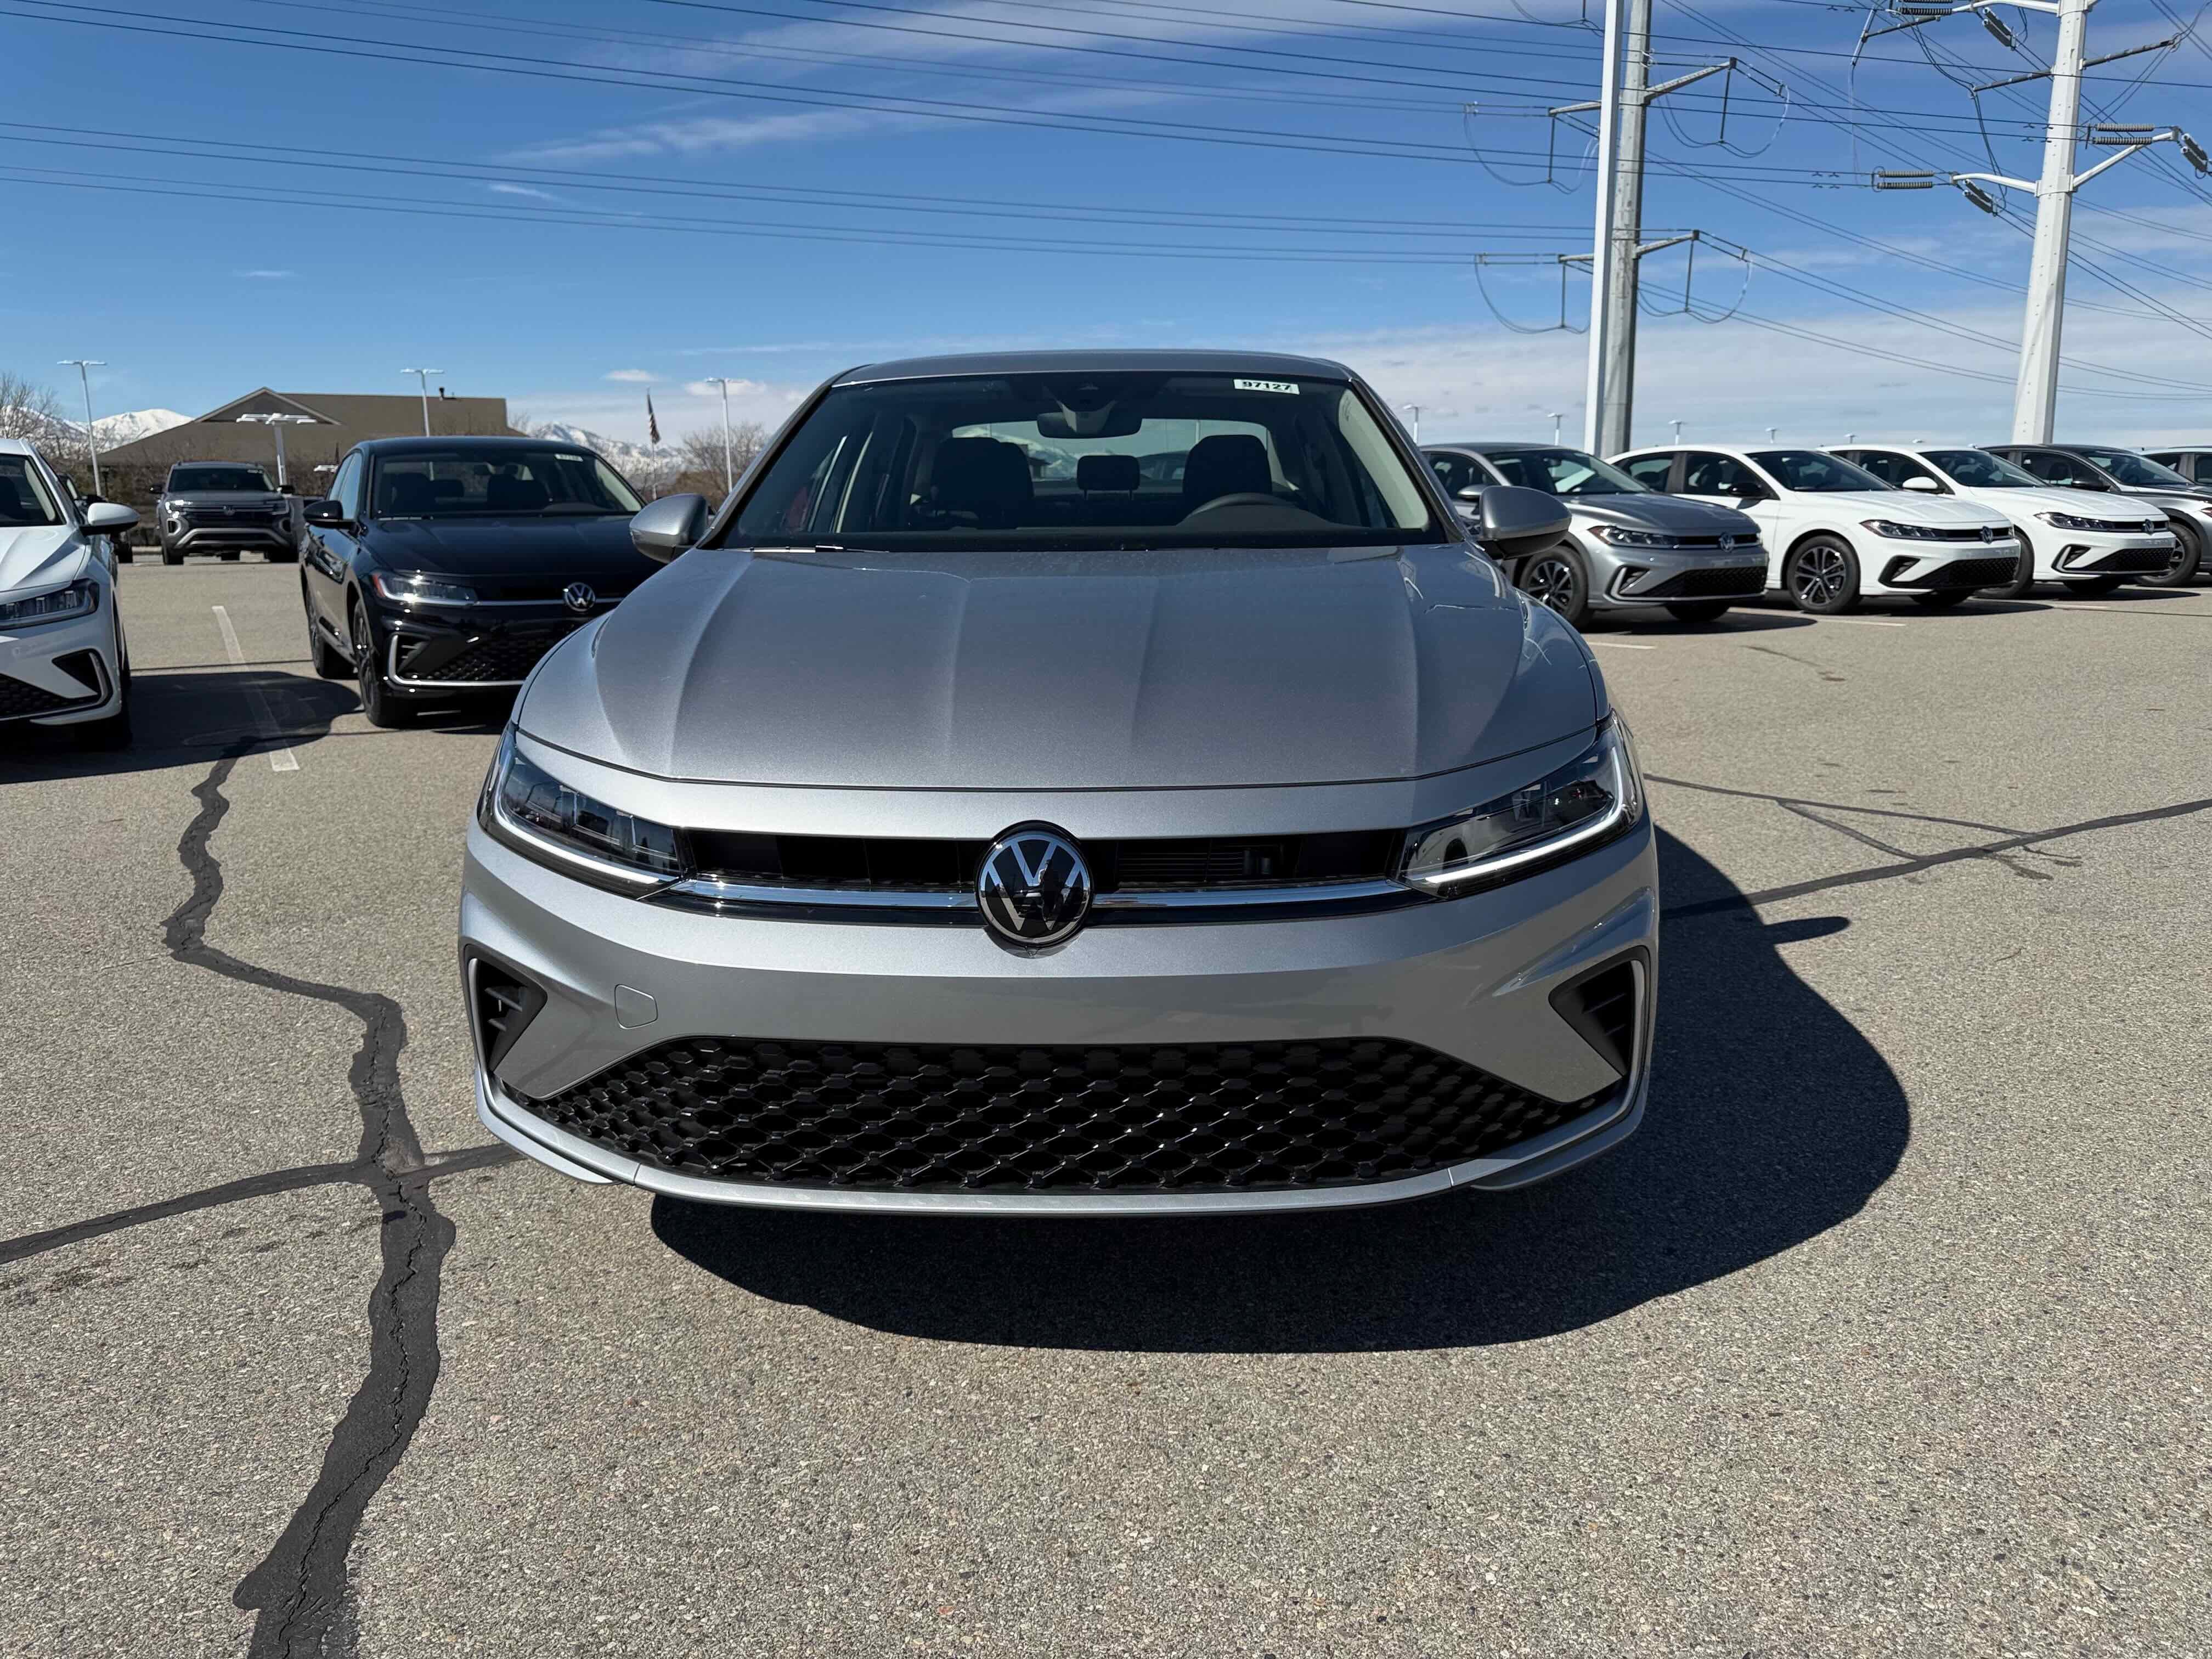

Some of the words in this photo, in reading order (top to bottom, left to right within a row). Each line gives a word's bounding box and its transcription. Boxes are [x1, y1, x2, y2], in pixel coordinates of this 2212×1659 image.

[1243, 381, 1291, 390] 97127
[565, 583, 595, 612] VW
[981, 831, 1088, 939] VW
